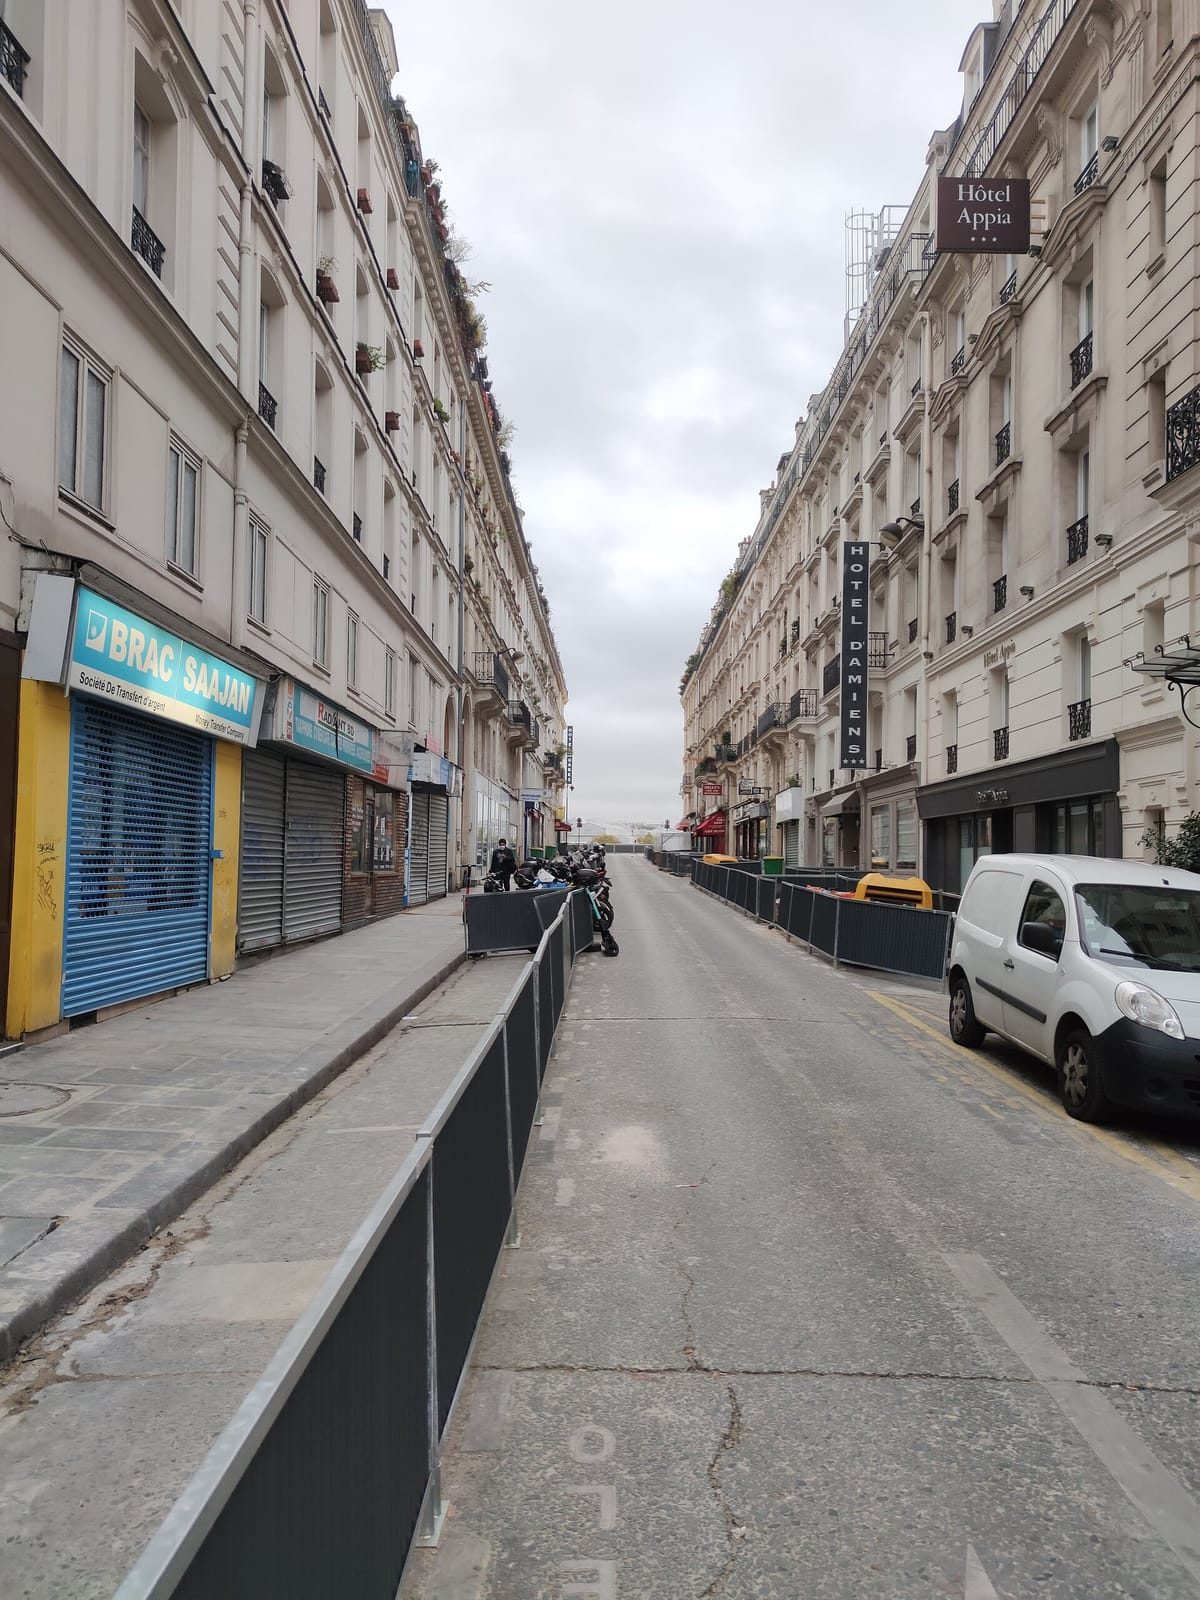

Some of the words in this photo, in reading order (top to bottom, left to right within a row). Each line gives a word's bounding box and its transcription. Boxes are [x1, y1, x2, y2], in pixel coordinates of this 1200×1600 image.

[957, 184, 1010, 202] Hôtel
[957, 207, 1011, 230] Appia
[850, 546, 864, 625] HOTEL
[109, 618, 175, 682] BRAC
[183, 655, 251, 715] SAAJAN
[79, 671, 106, 692] Société
[106, 681, 116, 695] De
[115, 685, 143, 706] Transfert
[143, 697, 166, 713] d'argent
[848, 640, 865, 754] D'AMIENS
[195, 713, 209, 728] Money
[210, 719, 227, 735] Transfer
[226, 725, 245, 741] Company
